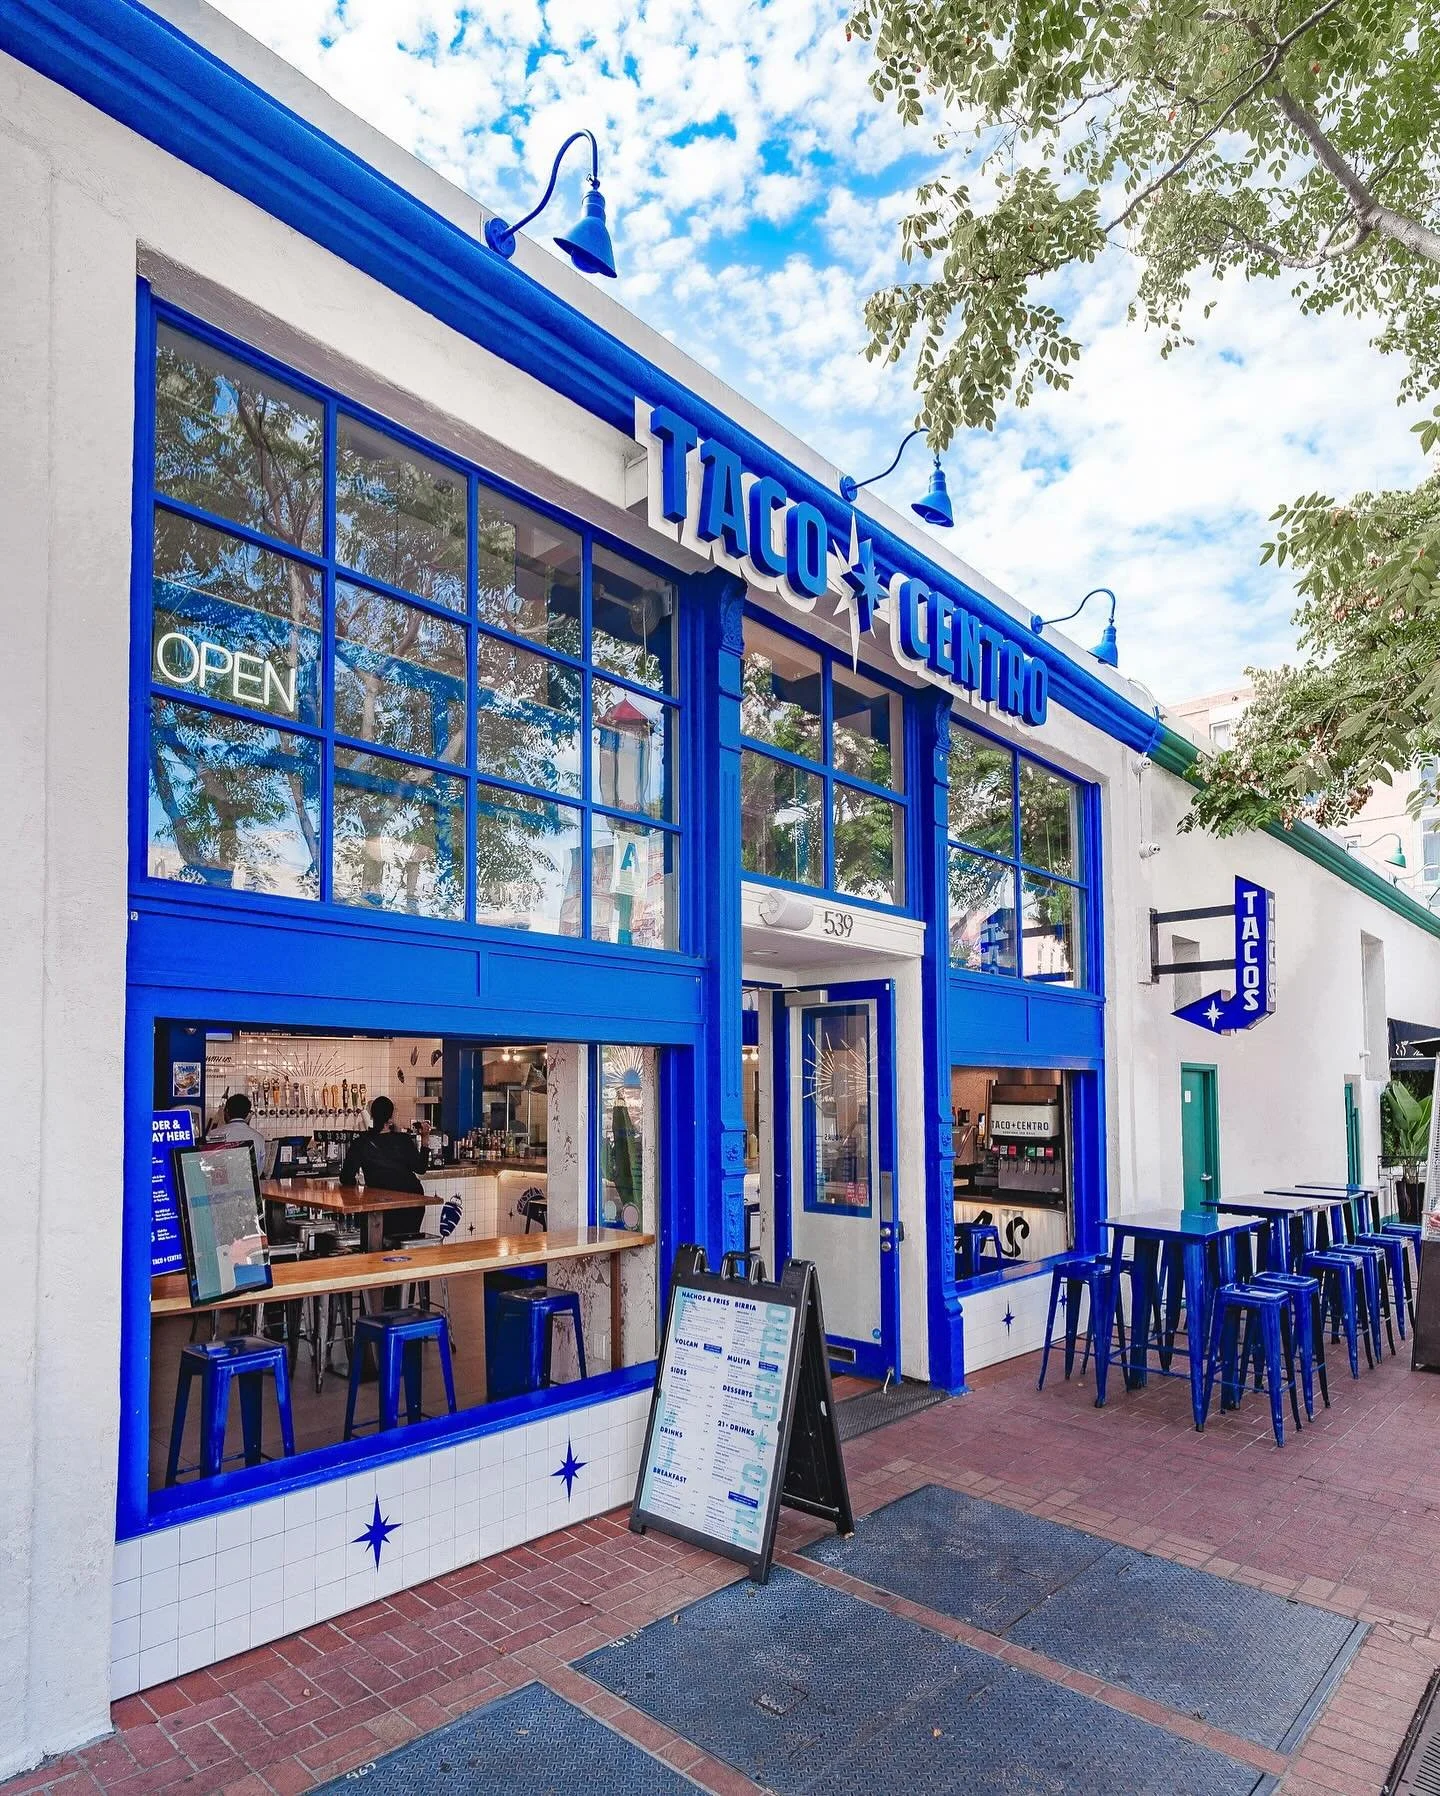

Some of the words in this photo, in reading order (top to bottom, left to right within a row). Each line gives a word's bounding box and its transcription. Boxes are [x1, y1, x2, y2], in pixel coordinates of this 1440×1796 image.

[651, 405, 827, 599] TACO
[900, 577, 1048, 726] CENTRO
[156, 632, 296, 712] OPEN
[620, 842, 641, 873] A
[823, 910, 854, 938] 539
[1242, 890, 1260, 1011] TACOS
[172, 1119, 181, 1130] &
[167, 1131, 190, 1141] HERE
[681, 1291, 706, 1302] NACHOS
[713, 1297, 730, 1306] FRIES
[734, 1301, 757, 1311] BIRRIA
[674, 1337, 699, 1349] VOLCAN
[727, 1355, 751, 1366] MULITA
[670, 1366, 688, 1376] SIDES
[722, 1384, 753, 1398] DESSERTS
[660, 1426, 683, 1438] DRINKS
[730, 1423, 755, 1436] DRINKS
[652, 1466, 688, 1484] BREAKFAST
